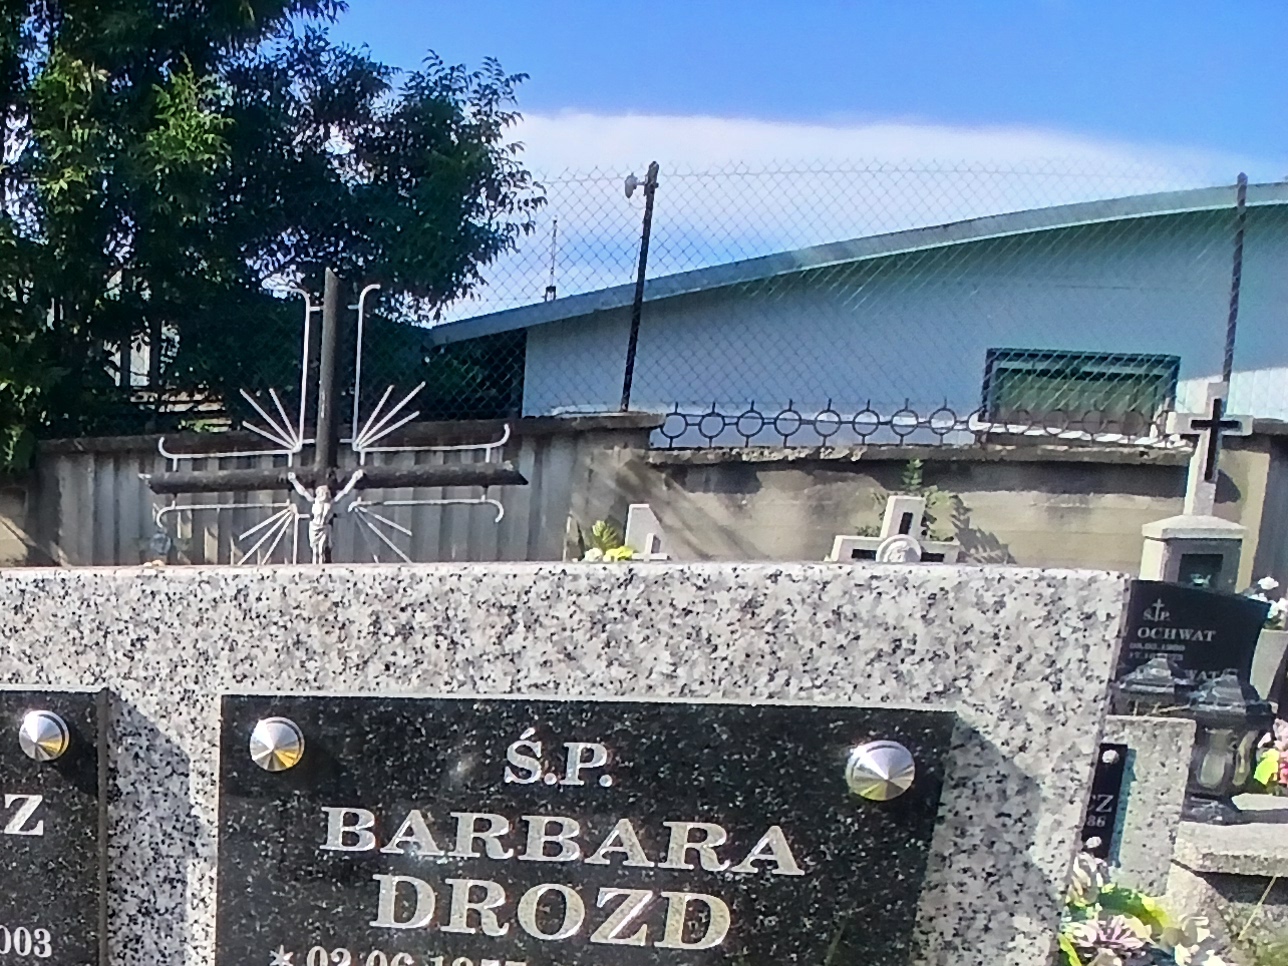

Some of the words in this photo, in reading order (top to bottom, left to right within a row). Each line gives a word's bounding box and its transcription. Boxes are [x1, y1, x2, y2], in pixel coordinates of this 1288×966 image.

[1137, 627, 1216, 642] OCHWAT
[503, 728, 614, 788] Ś.P.
[319, 805, 806, 876] BARBARA
[368, 873, 733, 951] DROZD
